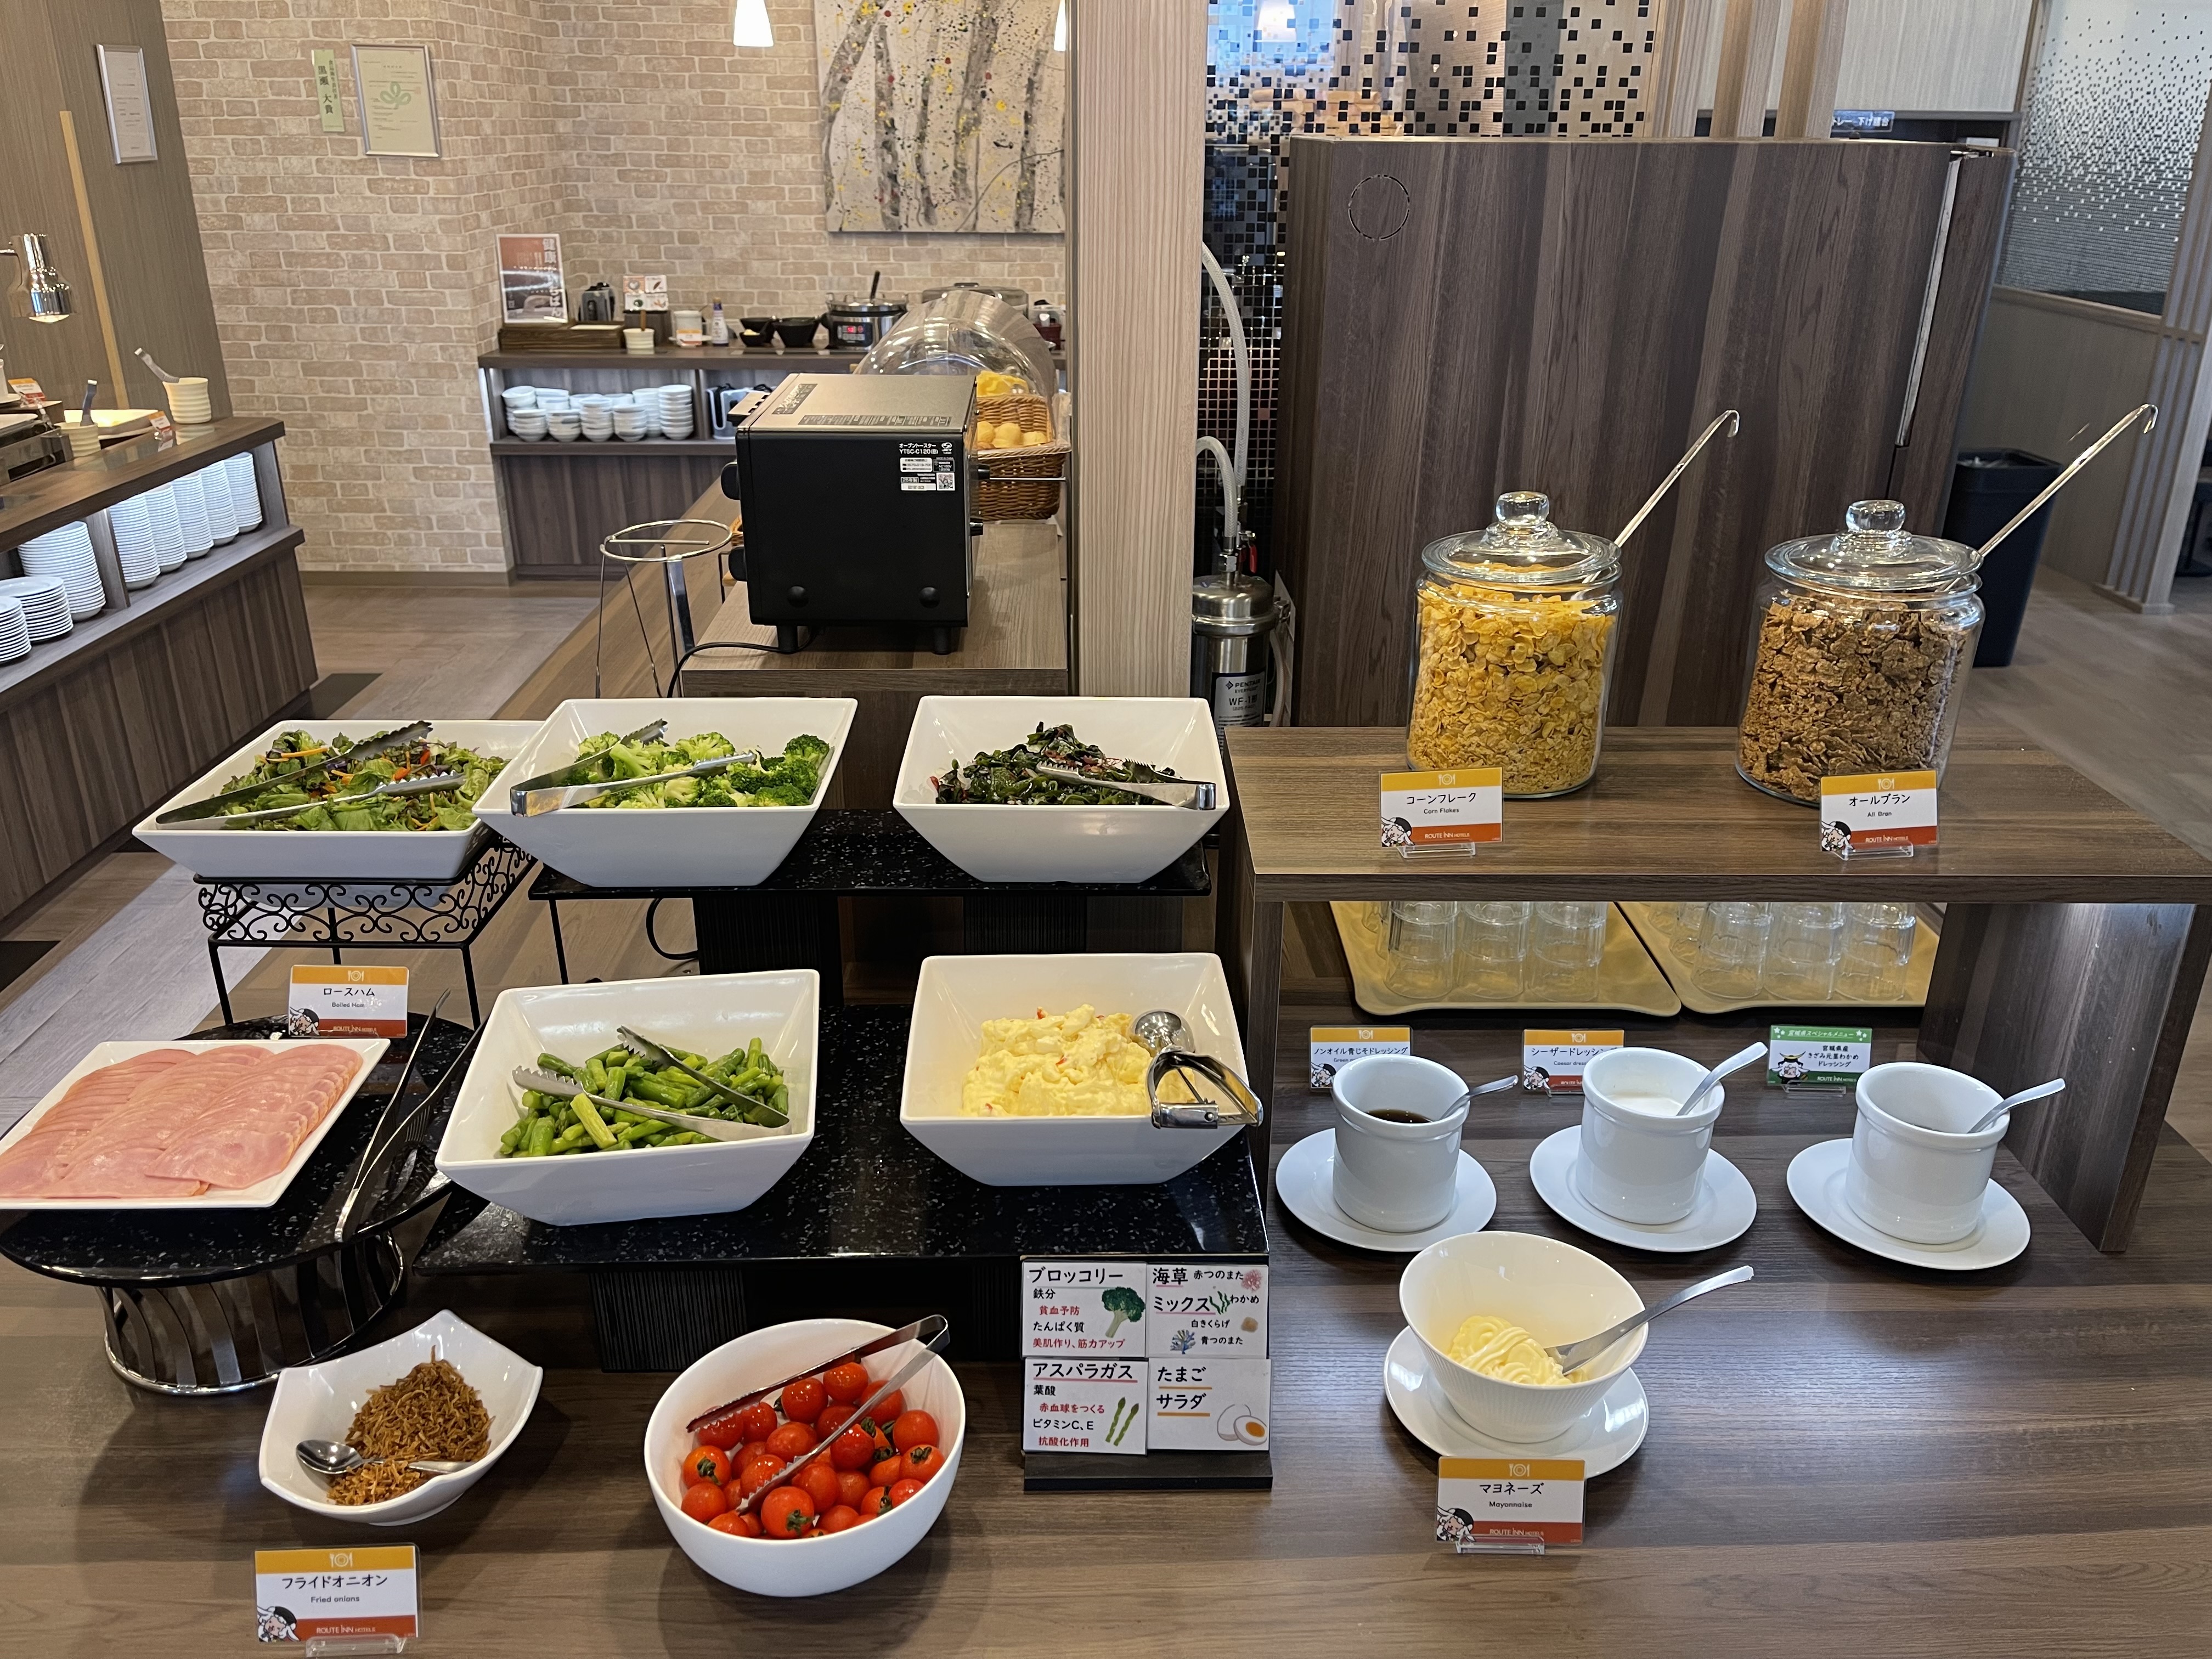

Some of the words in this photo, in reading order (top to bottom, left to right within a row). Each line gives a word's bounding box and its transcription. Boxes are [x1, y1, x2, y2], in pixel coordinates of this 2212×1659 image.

[1235, 679, 1261, 687] PENTAIR
[1407, 793, 1476, 804] コーンフレーク
[1849, 793, 1910, 806] オールブラン
[324, 988, 375, 996] ロースハム
[1314, 1047, 1409, 1055] ノンオイル青じそドレッシング
[1531, 1047, 1618, 1056] シーザードレッシ
[1029, 1266, 1123, 1284] ブロッコリー
[1153, 1267, 1188, 1285] 海草
[1193, 1269, 1244, 1280] 赤つのまた
[1033, 1288, 1056, 1299] 鉄分
[1230, 1294, 1260, 1304] わかめ
[1154, 1296, 1210, 1312] ミックス
[1040, 1305, 1080, 1316] 貧血予防
[1033, 1321, 1085, 1333] たんぱく質
[1191, 1319, 1230, 1328] 白きくらげ
[1032, 1338, 1126, 1348] 美肌作り、筋力アップ
[1201, 1336, 1243, 1345] 青つのまた
[1033, 1362, 1132, 1379] アスパラガス
[1158, 1367, 1206, 1382] たまご
[1033, 1384, 1056, 1396] 葉酸
[1156, 1392, 1207, 1409] サラダ
[1040, 1402, 1105, 1414] 赤血球をつくる
[1033, 1418, 1094, 1431] ビタミンC、E
[1039, 1436, 1089, 1447] 抗酸化作用
[1479, 1482, 1544, 1496] マヨネーズ
[282, 1574, 387, 1589] フライドオニオン
